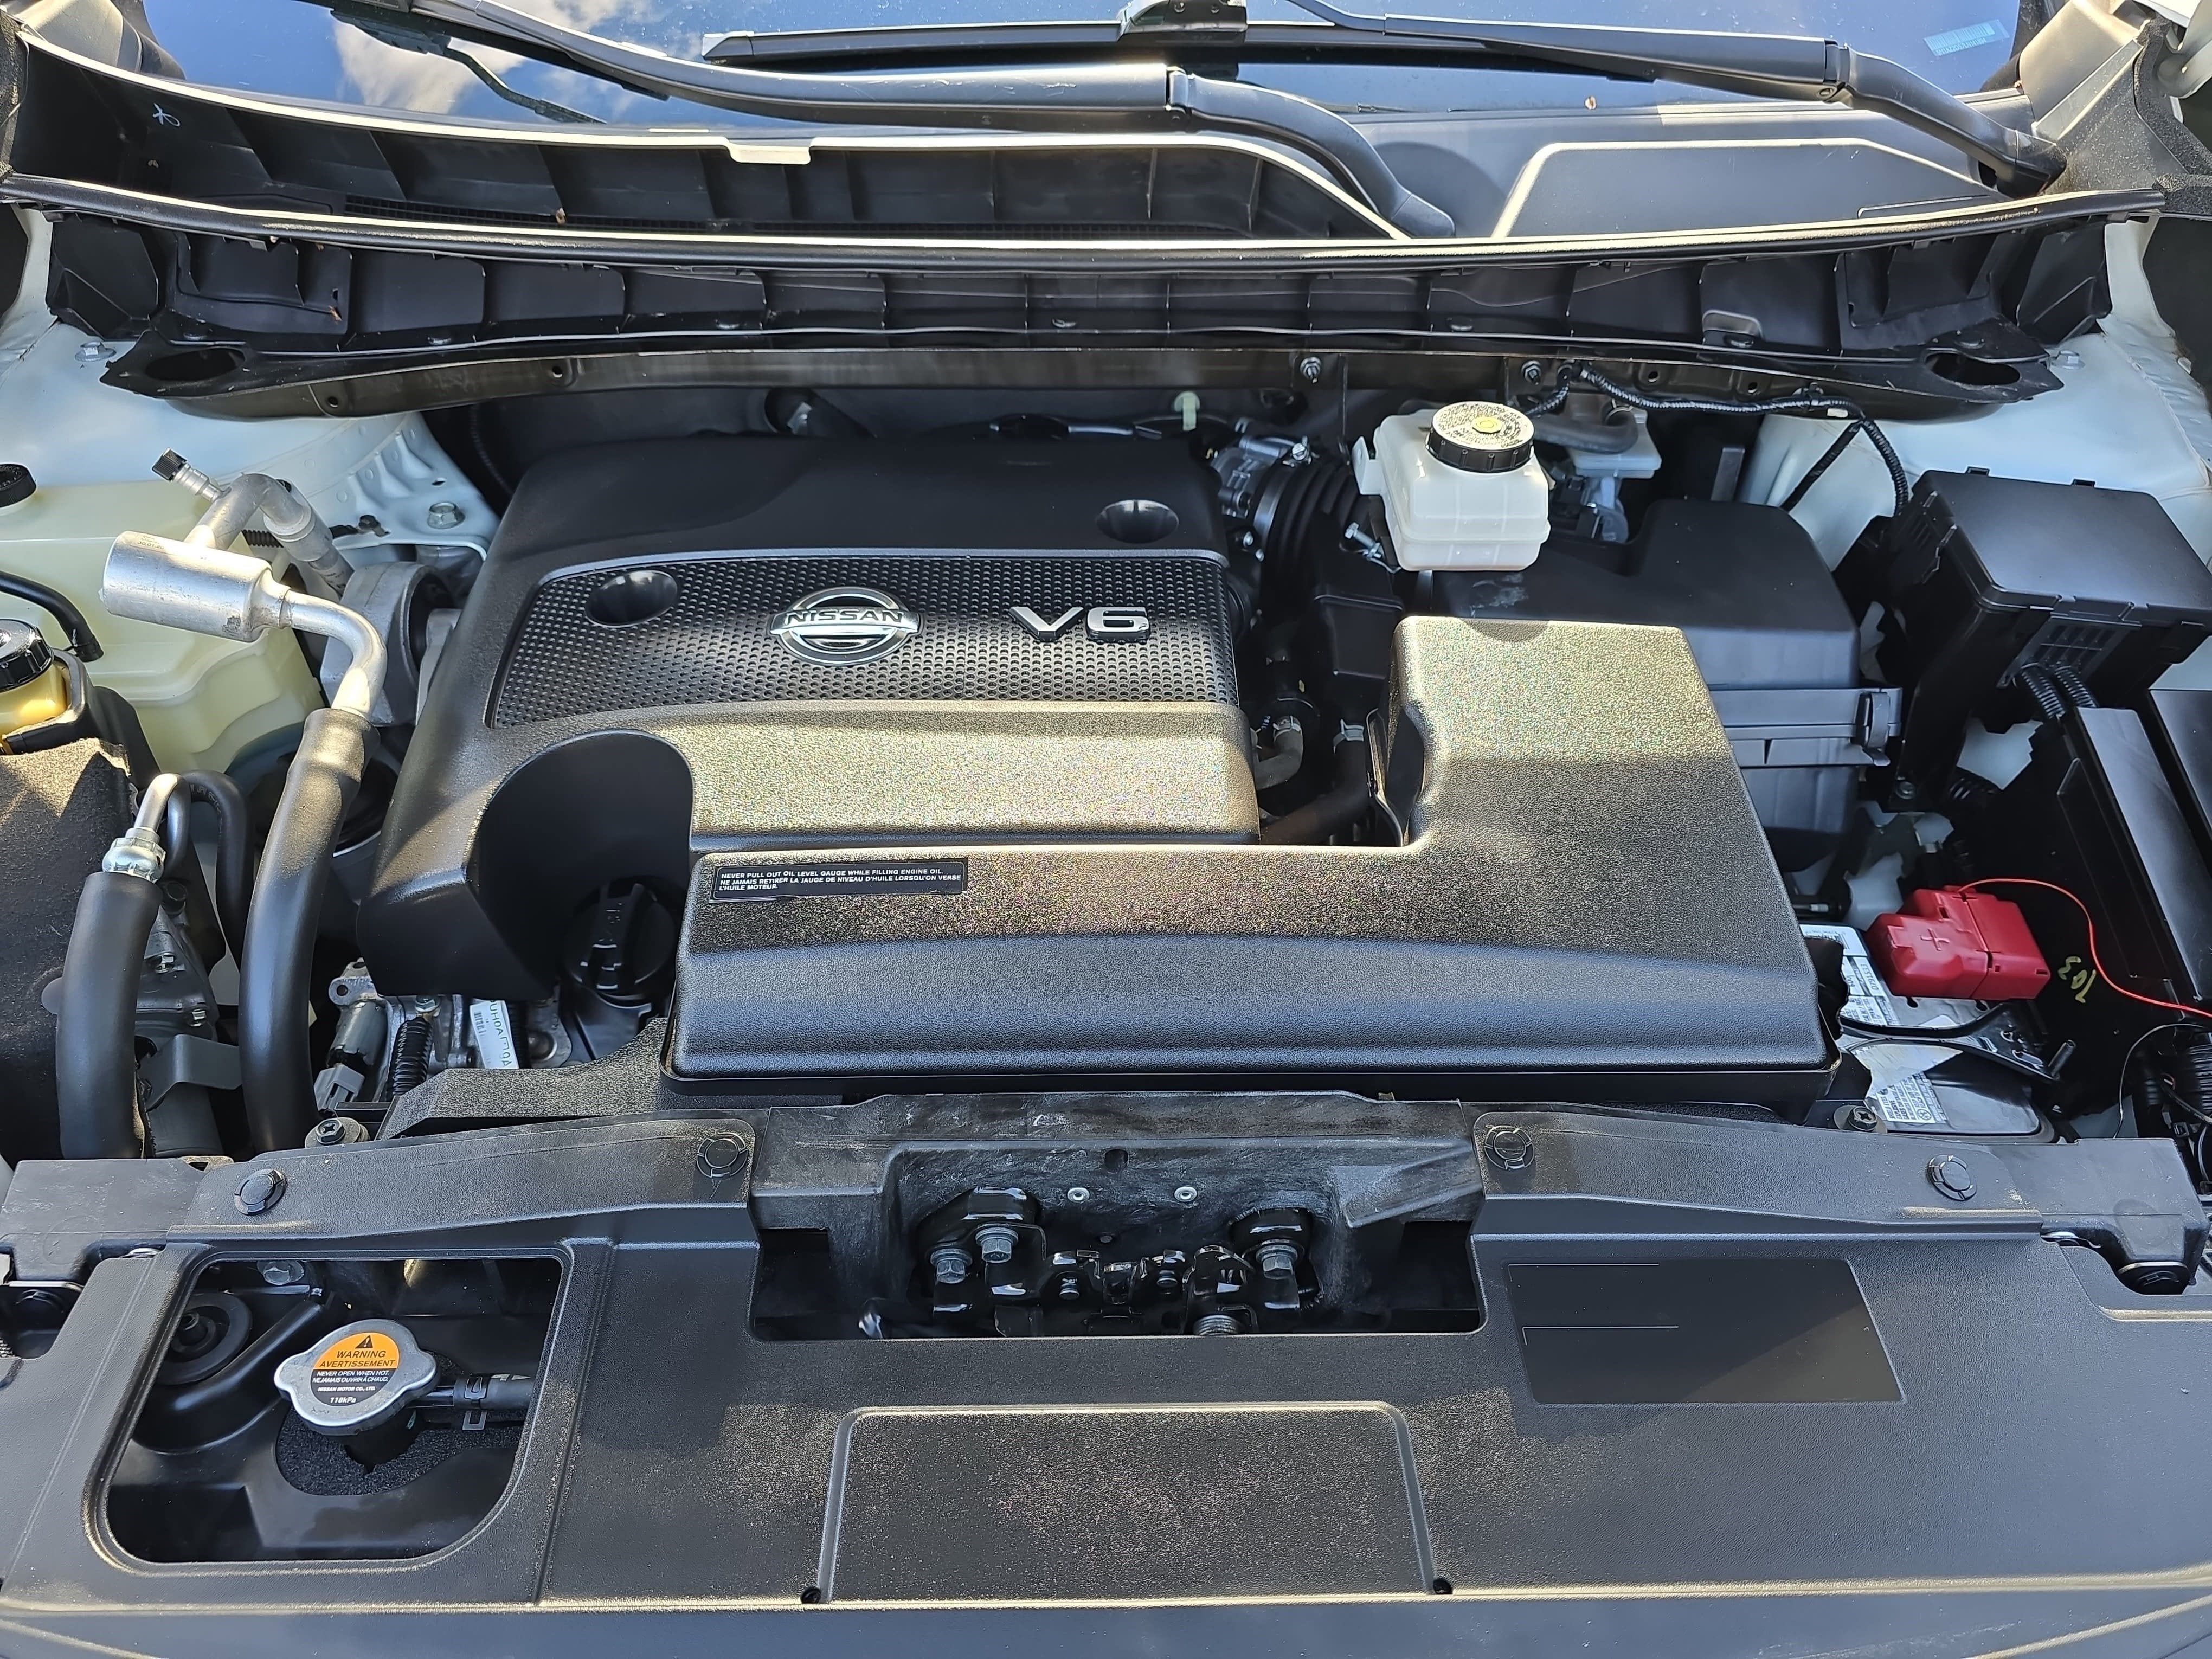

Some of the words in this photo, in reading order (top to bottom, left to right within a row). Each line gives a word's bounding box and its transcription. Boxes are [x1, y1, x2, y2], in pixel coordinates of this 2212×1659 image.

[786, 609, 904, 623] NISSAN
[1009, 606, 1150, 641] V6
[1860, 963, 1879, 989] 0791533
[336, 1350, 387, 1358] WARNING
